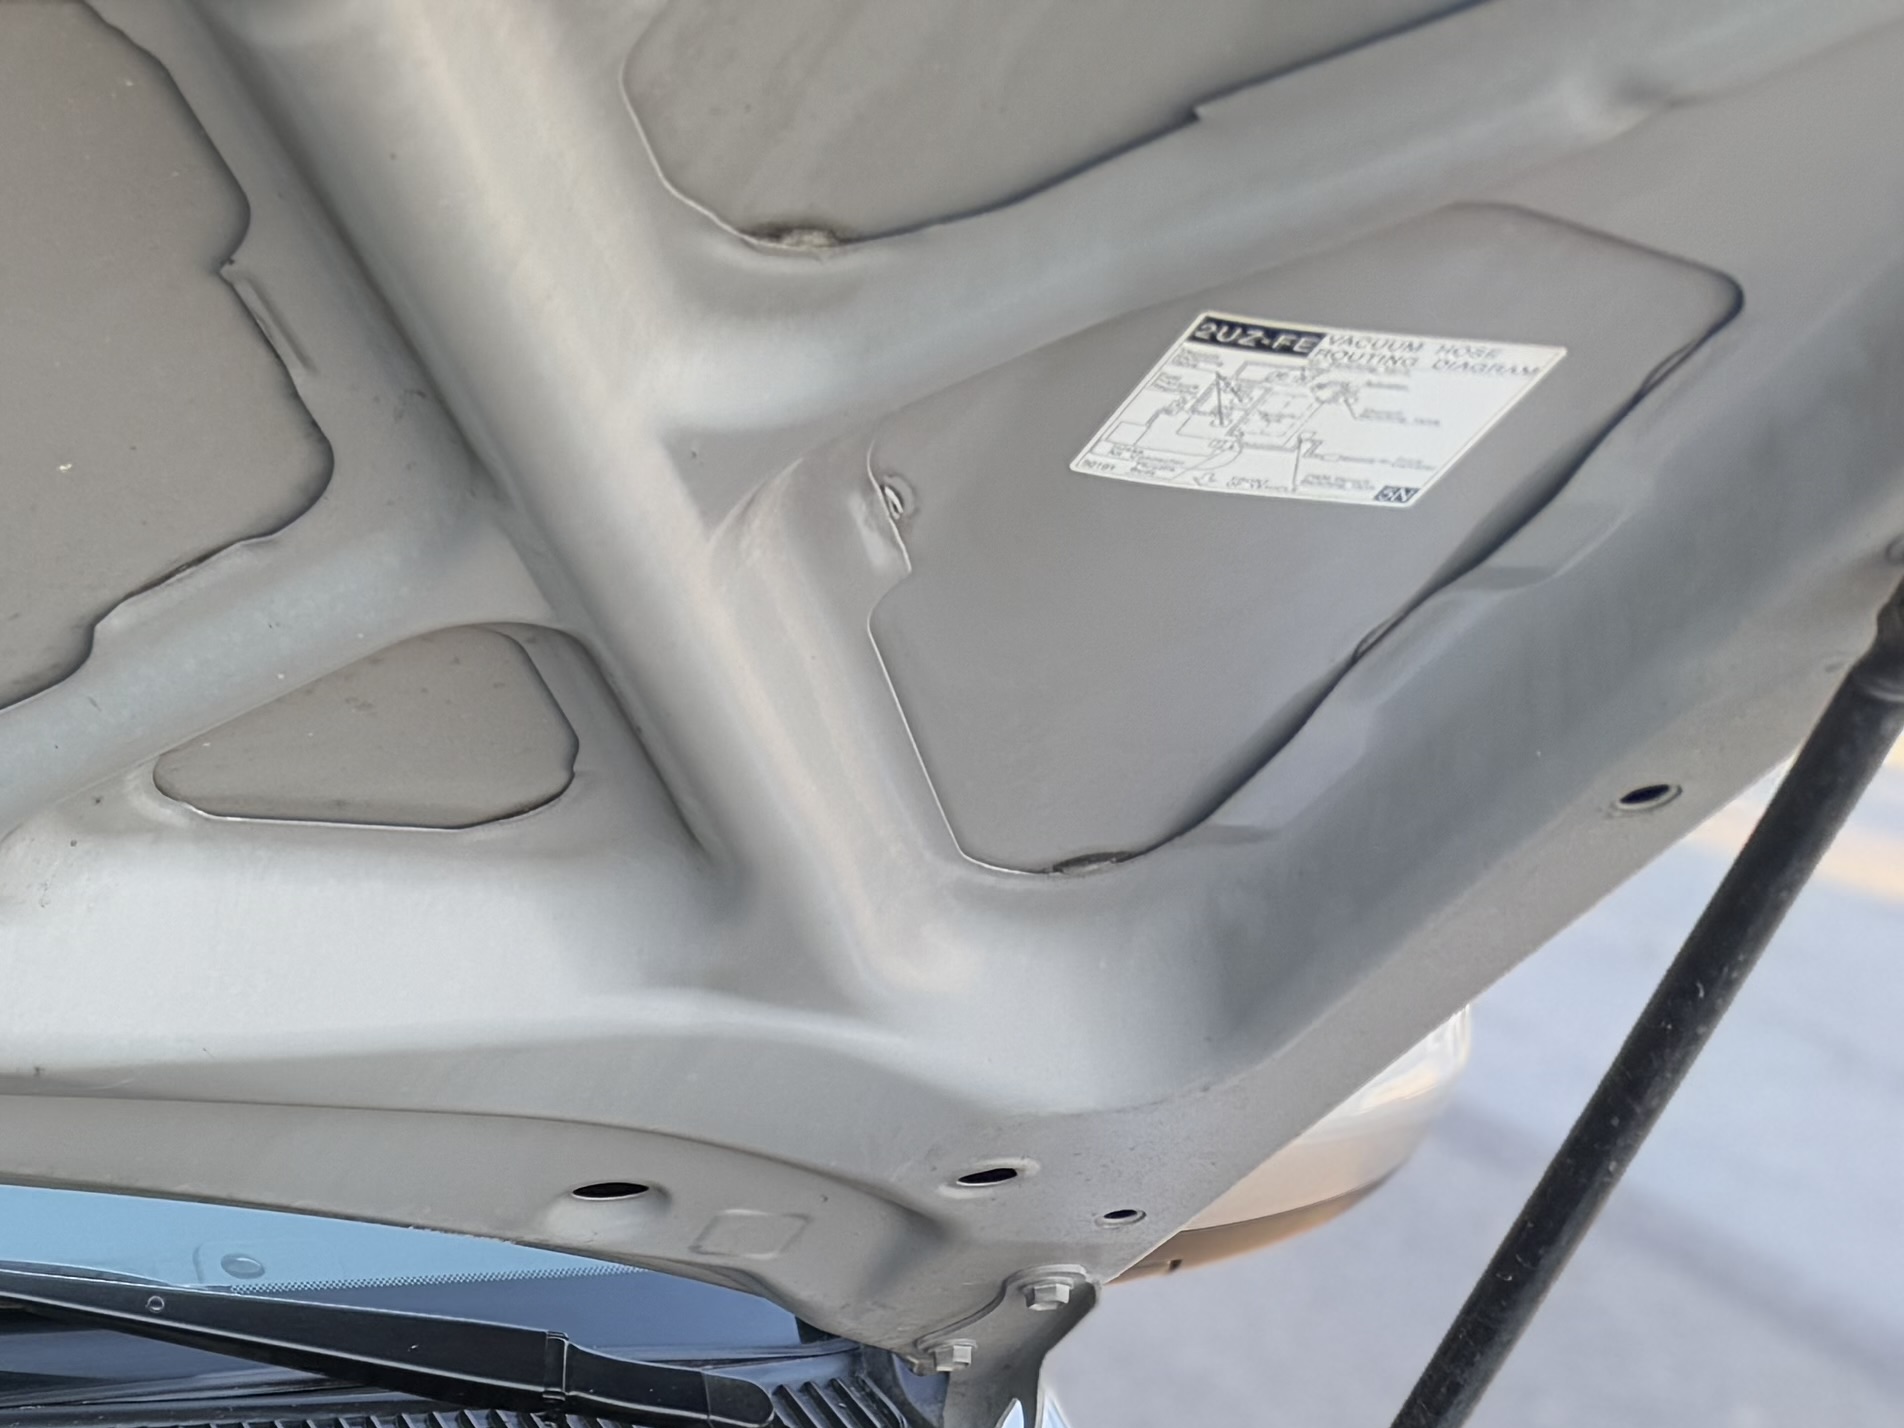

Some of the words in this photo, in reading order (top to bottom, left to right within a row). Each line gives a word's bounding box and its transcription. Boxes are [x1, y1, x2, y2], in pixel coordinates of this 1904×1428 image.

[1194, 321, 1318, 356] 2UZ-FE
[1328, 335, 1424, 352] VACUUM
[1437, 345, 1499, 359] HOSE
[1315, 350, 1417, 367] ROUTING
[1433, 360, 1542, 376] DIAGRAM
